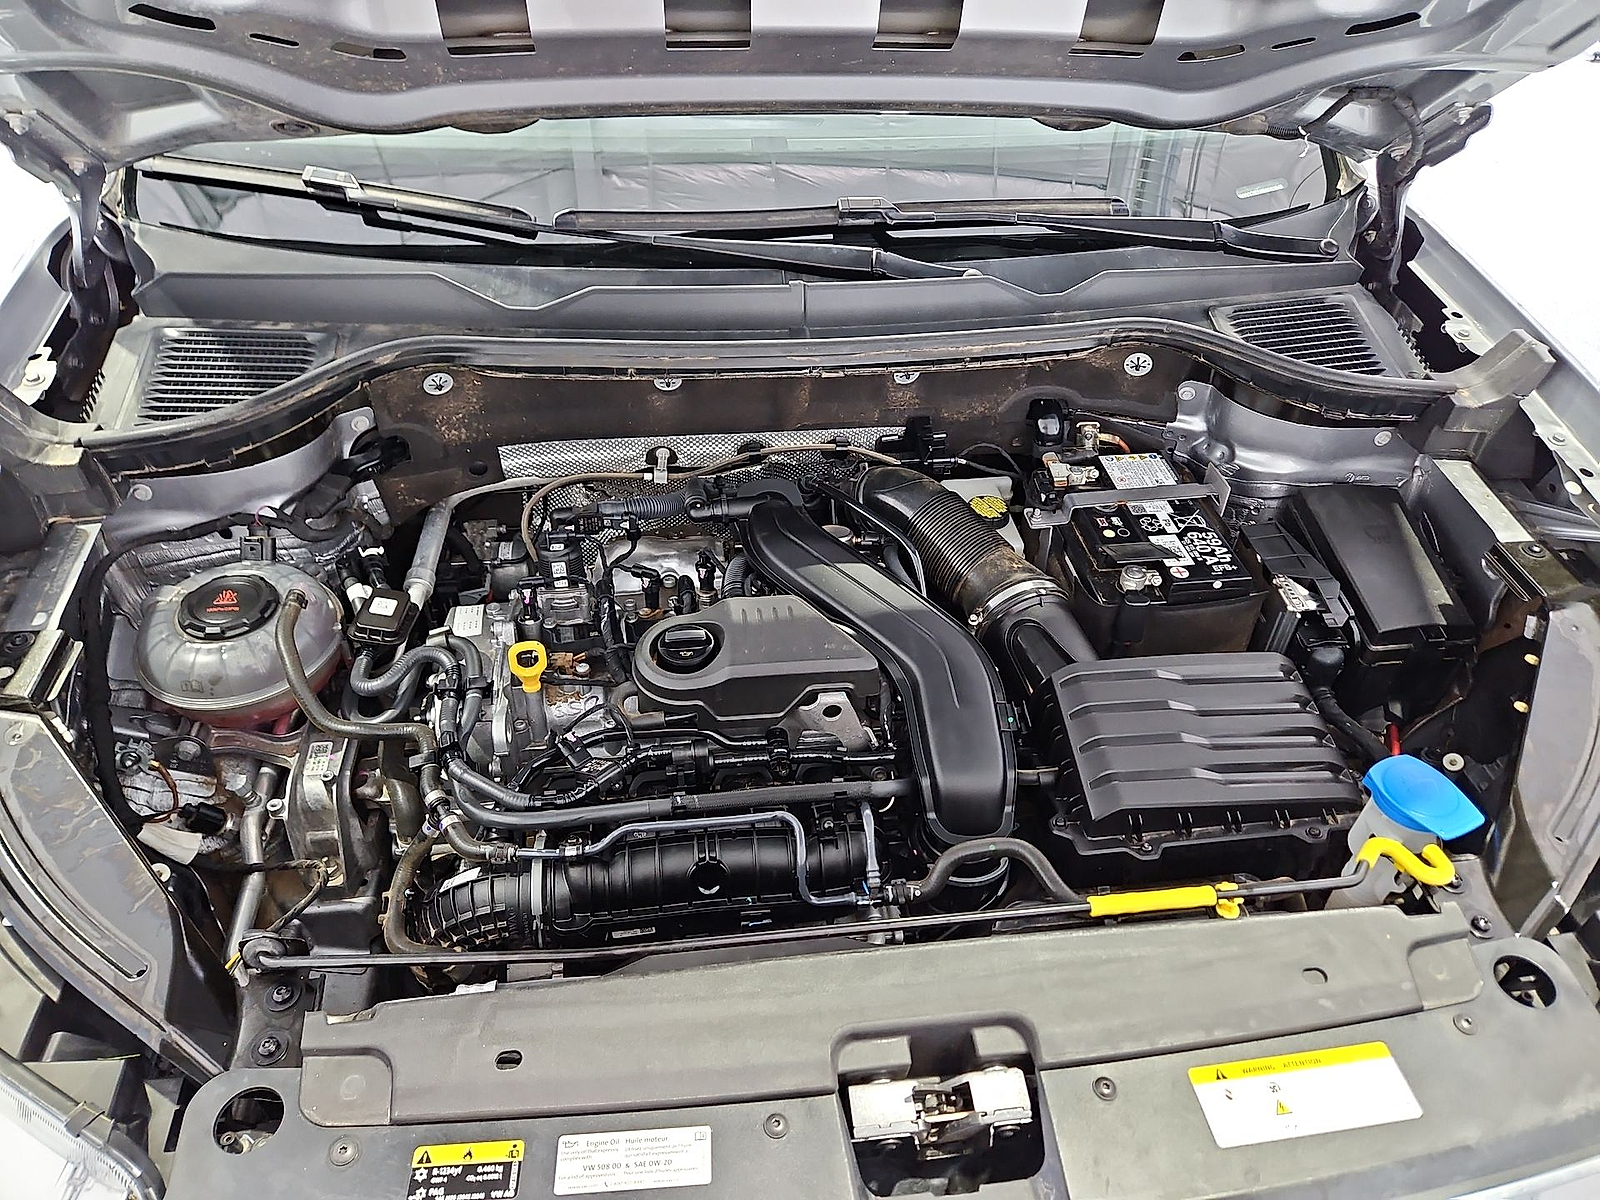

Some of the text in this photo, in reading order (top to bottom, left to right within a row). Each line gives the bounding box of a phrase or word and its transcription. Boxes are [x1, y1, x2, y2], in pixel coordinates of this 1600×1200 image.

[1187, 531, 1212, 553] 640
[1201, 555, 1220, 566] A
[1201, 531, 1233, 563] 59Ah
[1211, 563, 1238, 572] EFB+
[1283, 1058, 1322, 1068] ATTENTION
[586, 1140, 608, 1149] Engine
[610, 1138, 620, 1146] Oil
[597, 1163, 610, 1171] 508
[611, 1162, 622, 1170] 00
